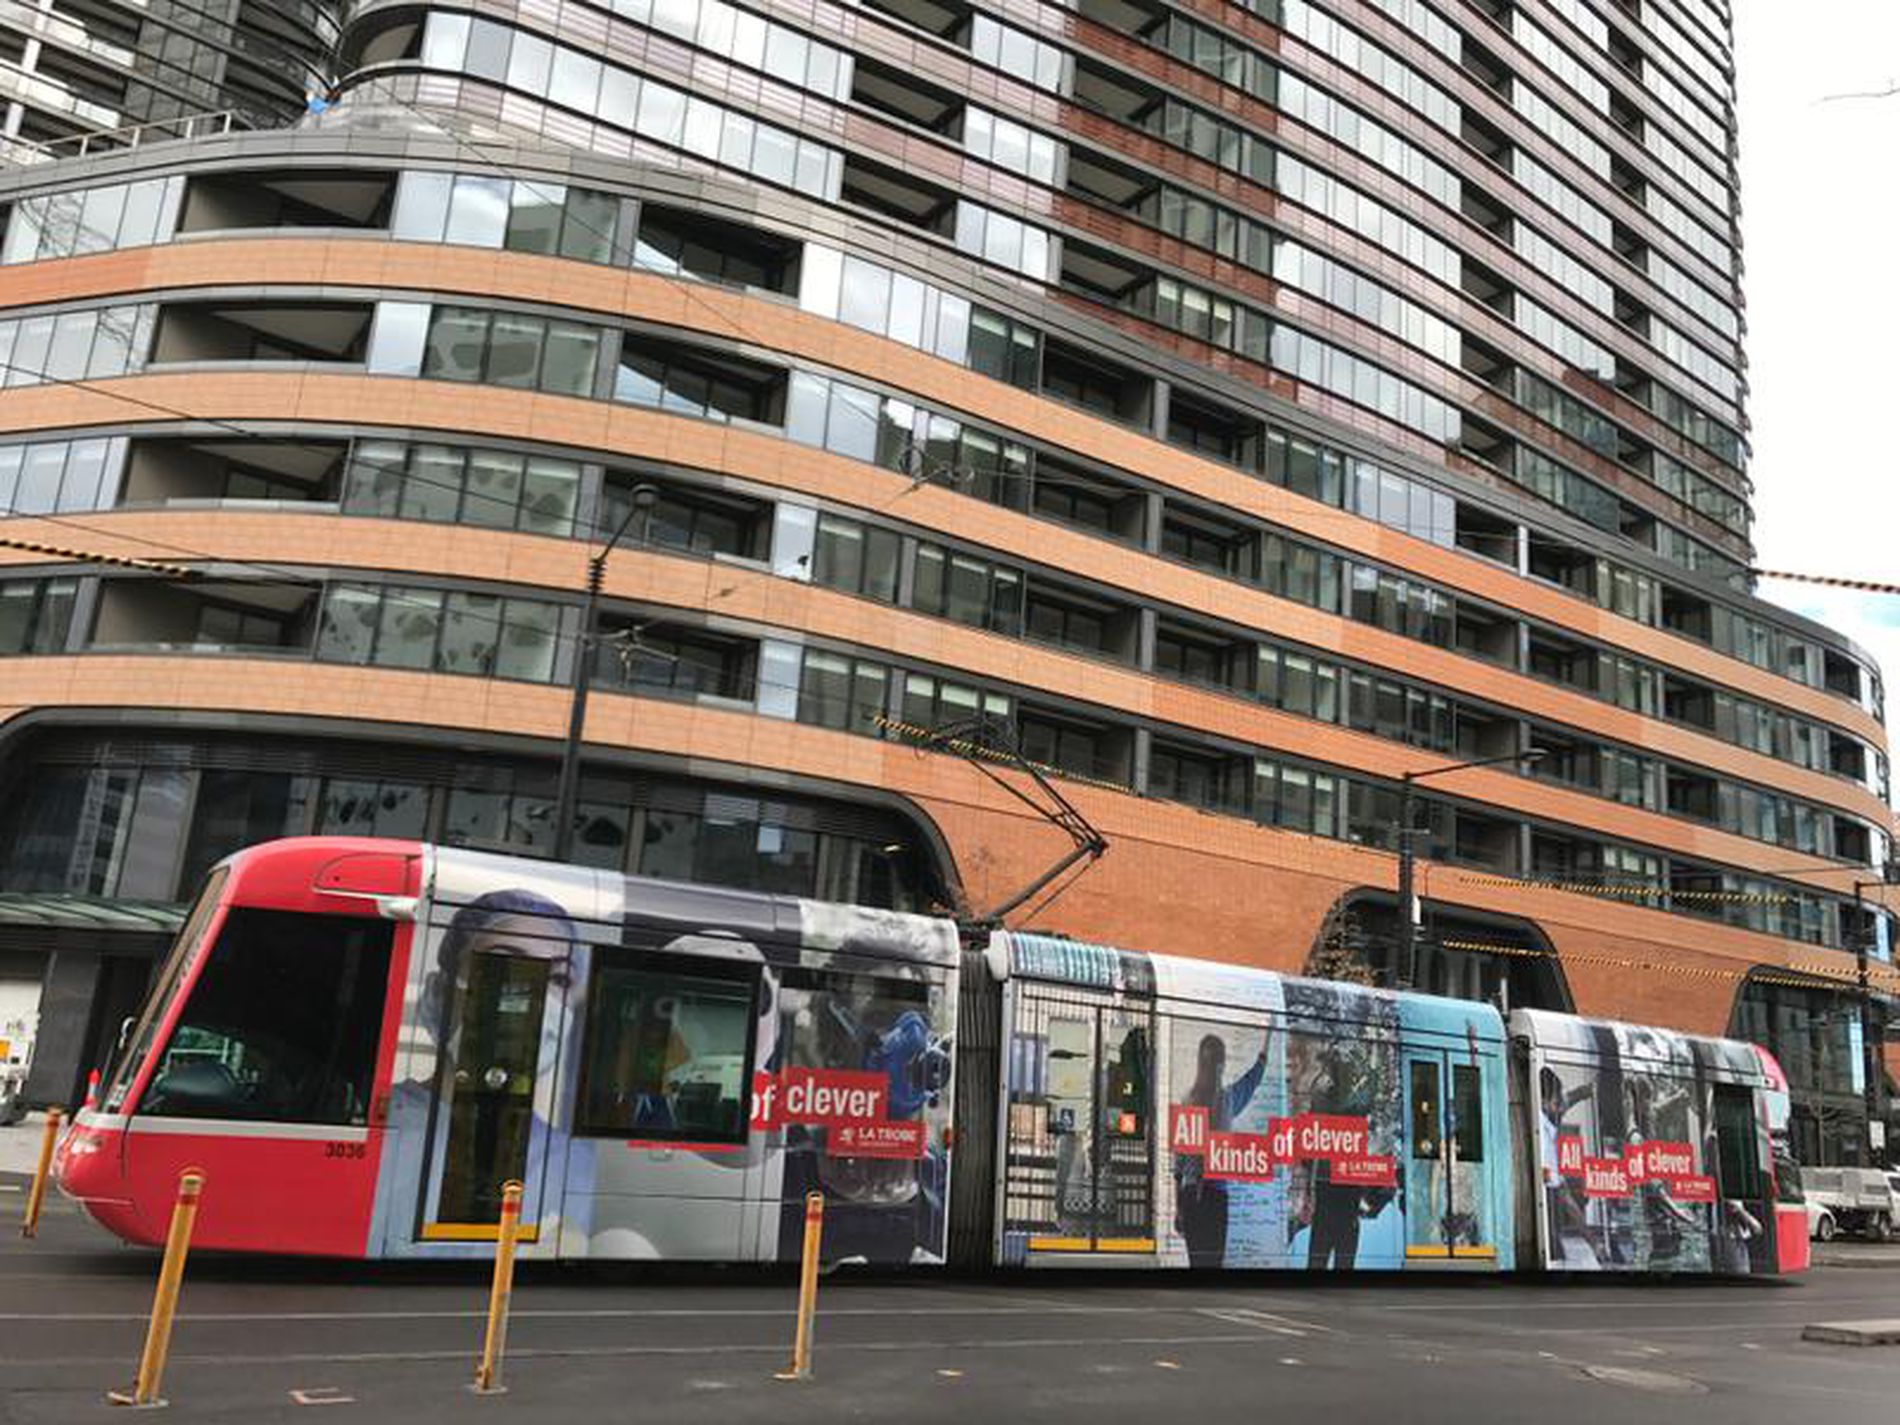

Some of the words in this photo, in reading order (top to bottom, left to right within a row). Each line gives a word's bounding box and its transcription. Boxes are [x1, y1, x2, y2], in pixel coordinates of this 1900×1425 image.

[787, 1076, 881, 1118] clever
[1174, 1113, 1203, 1146] All
[1209, 1140, 1268, 1174] kinds
[1273, 1128, 1294, 1157] of
[1302, 1121, 1363, 1154] clever
[1562, 1142, 1581, 1170] All
[1585, 1165, 1628, 1192] kinds
[1628, 1151, 1644, 1178] of
[1649, 1148, 1690, 1174] clever
